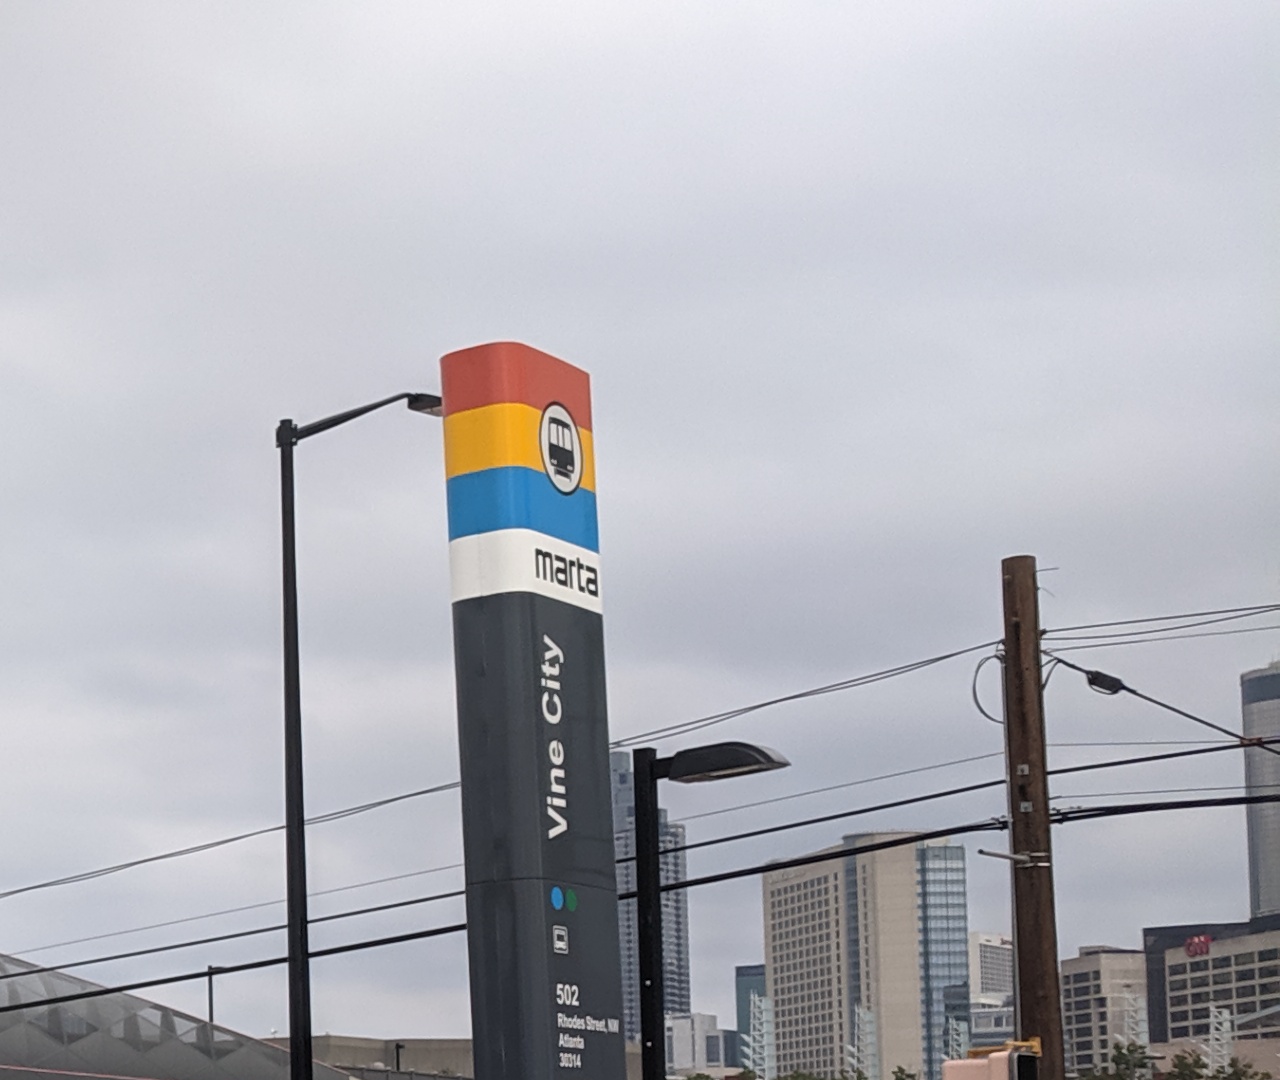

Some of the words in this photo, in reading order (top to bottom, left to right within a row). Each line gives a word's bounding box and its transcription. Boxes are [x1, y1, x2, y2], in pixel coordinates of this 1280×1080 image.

[535, 548, 598, 597] marta
[541, 634, 564, 725] City
[547, 739, 569, 839] Vine
[556, 983, 580, 1006] 502
[557, 1012, 585, 1030] Rhodes
[585, 1015, 607, 1034] Street,
[607, 1018, 619, 1033] NW
[558, 1033, 585, 1049] Atlanta
[559, 1052, 581, 1068] 30314
